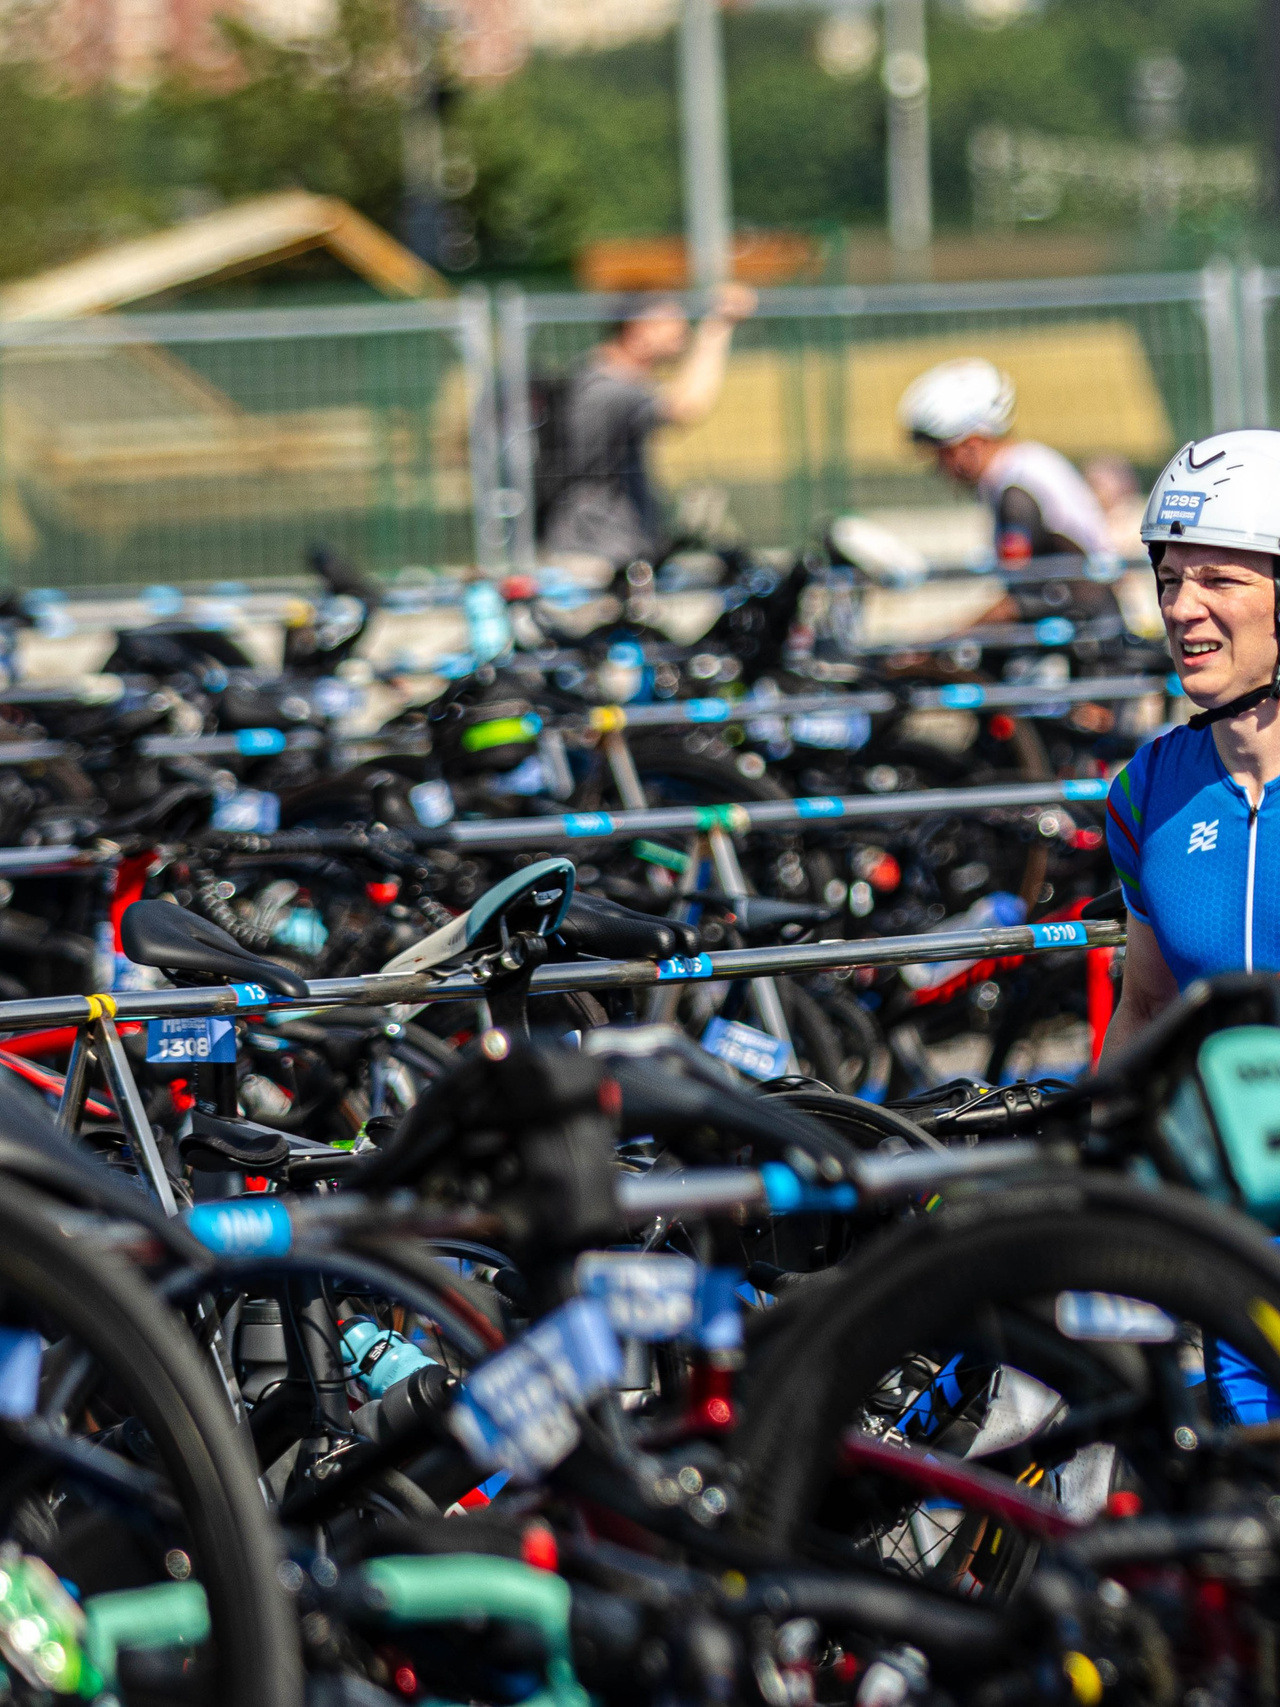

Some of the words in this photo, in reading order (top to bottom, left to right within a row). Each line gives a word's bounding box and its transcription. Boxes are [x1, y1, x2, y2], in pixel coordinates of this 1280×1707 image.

[1165, 494, 1201, 508] 1295
[1042, 924, 1076, 941] 1310
[158, 1036, 210, 1058] 1308
